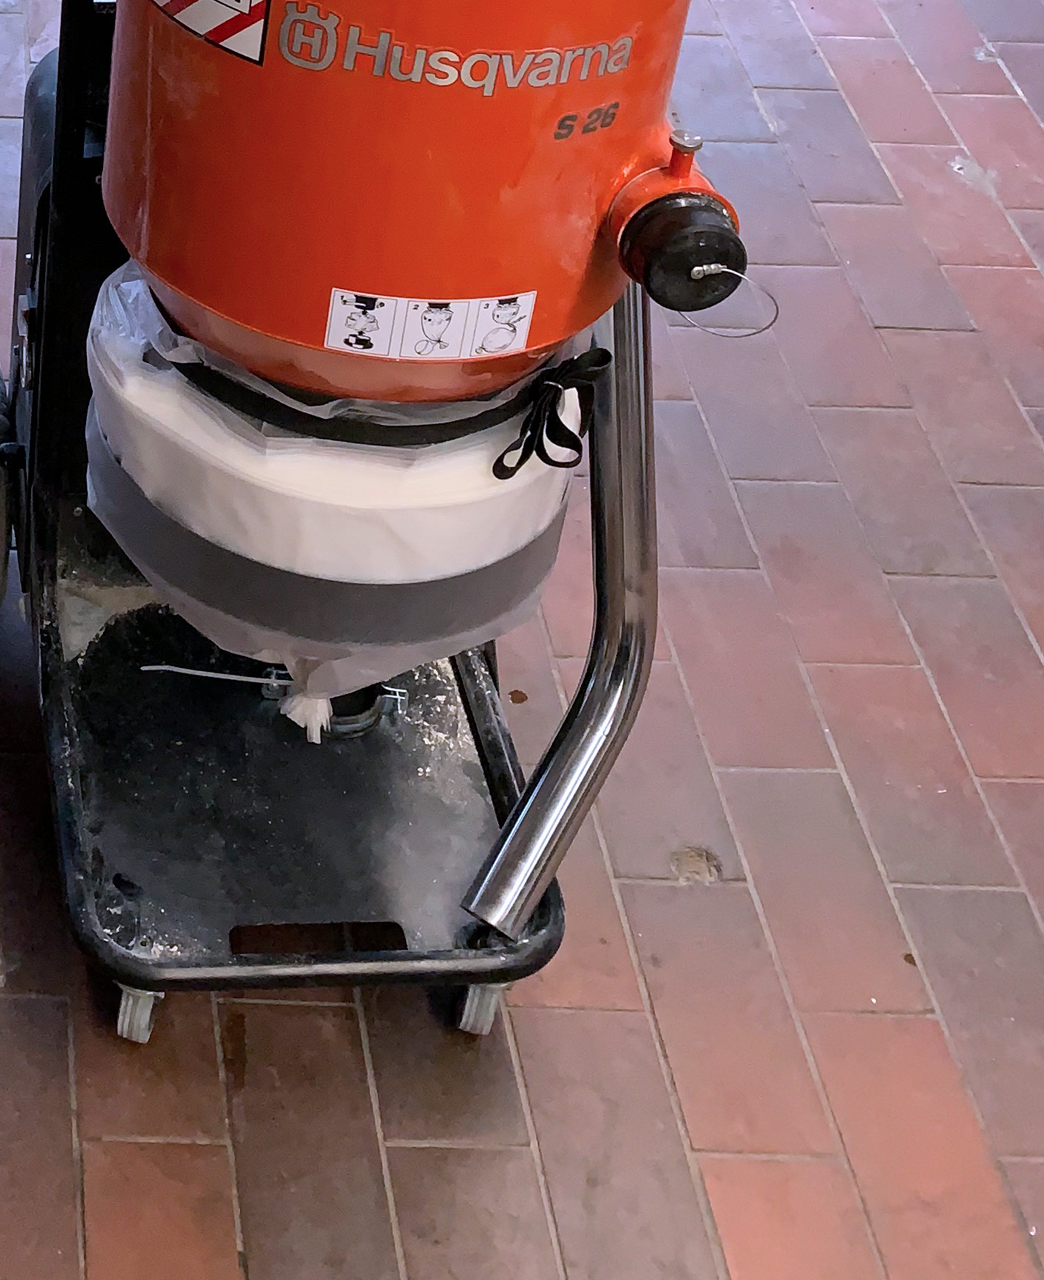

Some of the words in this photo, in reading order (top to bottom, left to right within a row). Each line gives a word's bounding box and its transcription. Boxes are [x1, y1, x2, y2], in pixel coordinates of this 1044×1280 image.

[342, 25, 633, 97] Husqvarna
[553, 114, 578, 141] S
[581, 102, 621, 136] 26
